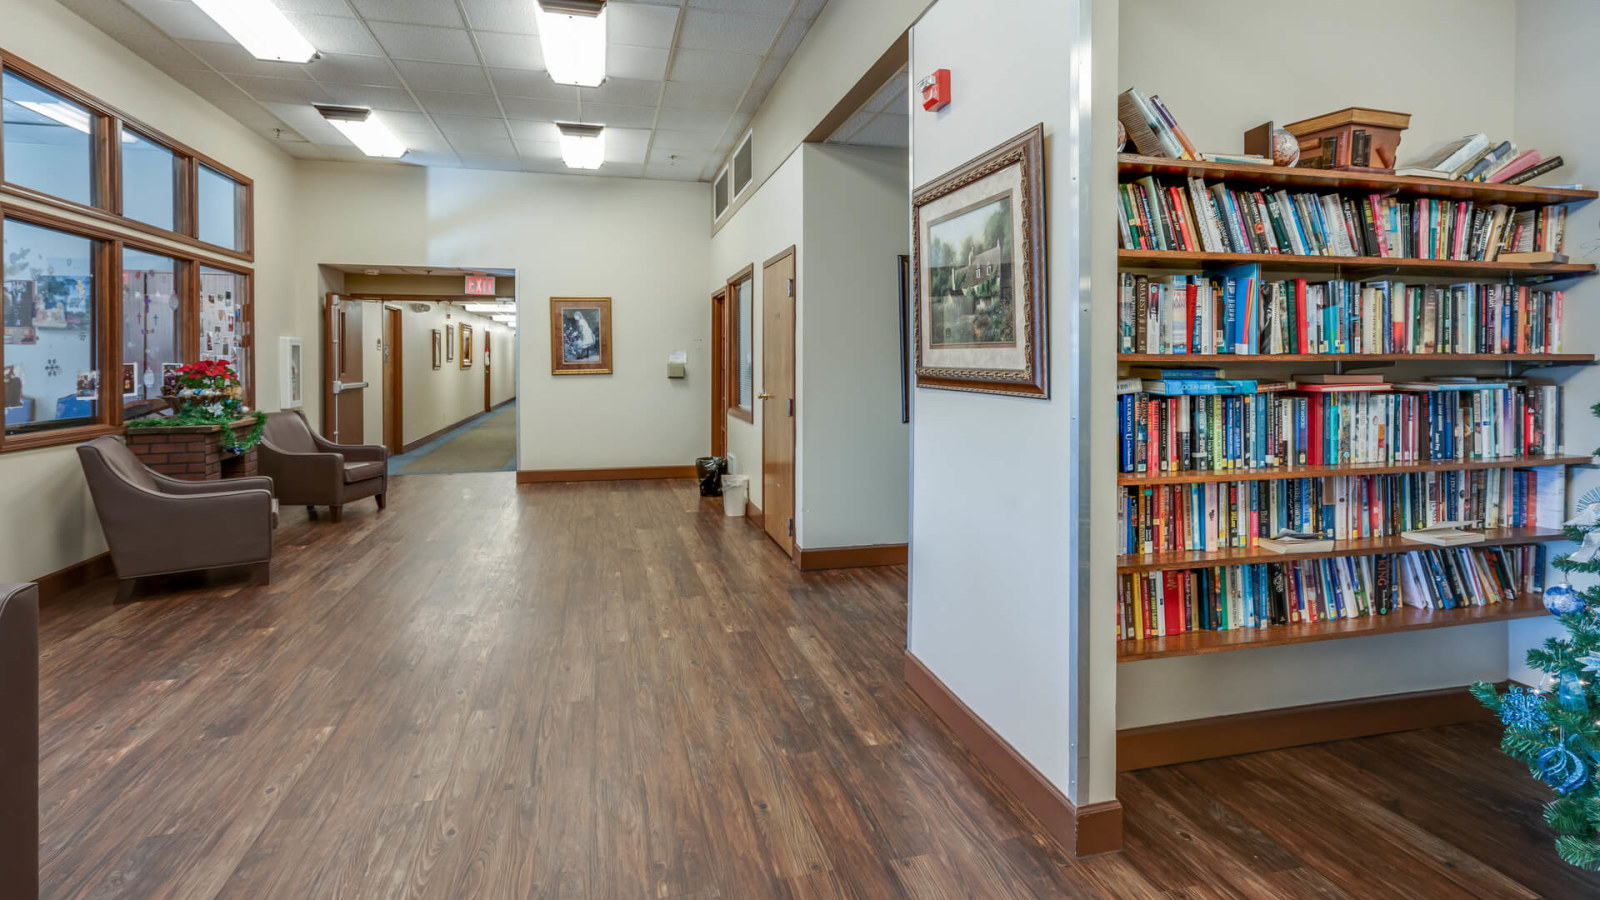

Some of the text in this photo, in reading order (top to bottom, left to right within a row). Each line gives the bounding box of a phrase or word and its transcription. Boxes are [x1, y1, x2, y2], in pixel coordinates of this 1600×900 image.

[467, 277, 494, 293] EXIT
[1139, 283, 1147, 318] MAJESTY
[1377, 560, 1387, 586] KING
